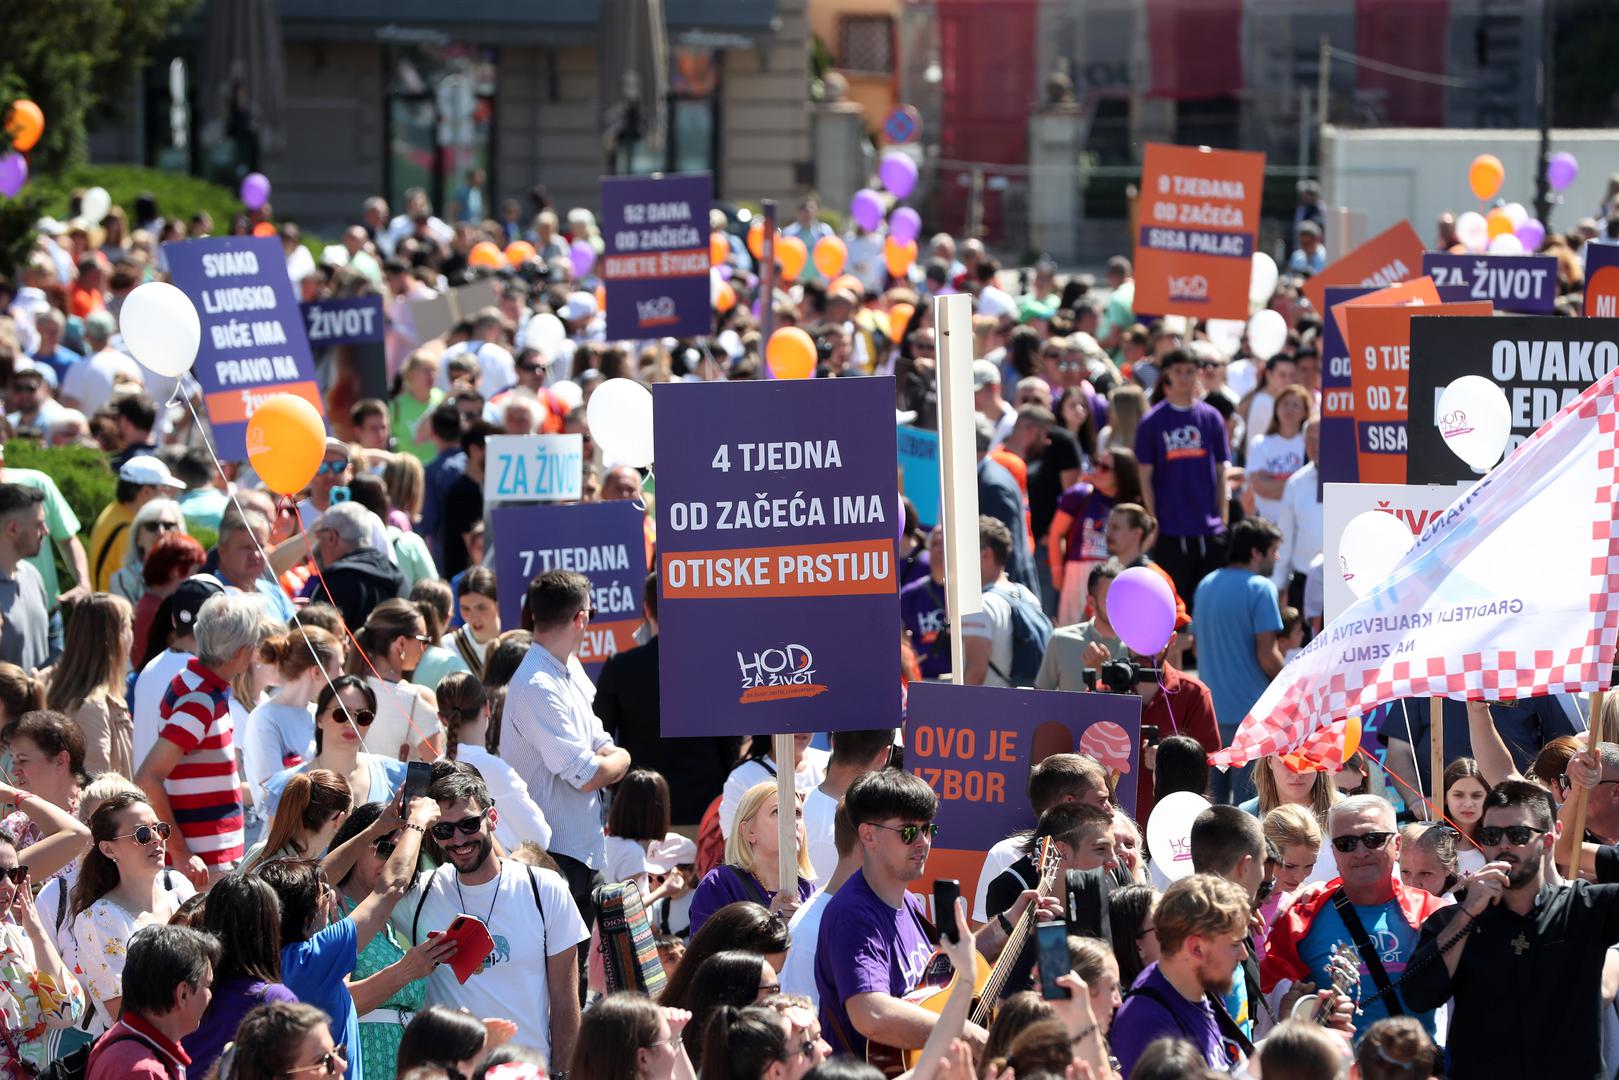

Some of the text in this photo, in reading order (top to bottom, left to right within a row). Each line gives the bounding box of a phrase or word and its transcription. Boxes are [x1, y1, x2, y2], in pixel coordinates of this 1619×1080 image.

[1173, 176, 1245, 199] TJEDANA
[1154, 202, 1177, 222] OD
[615, 231, 639, 250] OD
[1149, 229, 1245, 255] SISA PALAC
[202, 251, 259, 277] SVAKO
[1471, 261, 1547, 299] ŽIVOT
[202, 285, 277, 313] LJUDSKO
[210, 318, 287, 349] BIĆE IMA
[308, 305, 376, 341] ŽIVOT
[215, 355, 299, 385] PRAVO NA
[1364, 346, 1377, 371] 9
[1492, 340, 1618, 382] OVAKO
[1366, 386, 1391, 411] OD
[1368, 425, 1408, 451] SISA
[711, 439, 842, 473] 4 TJEDNA
[497, 454, 528, 494] ZA
[670, 491, 885, 531] OD ZAČEĆA IMA
[519, 551, 535, 577] 7
[668, 551, 889, 588] OTISKE PRSTIJU
[737, 644, 813, 679] HOD
[741, 670, 816, 688] ZA ŽIVOT
[914, 725, 1018, 762] OVO JE
